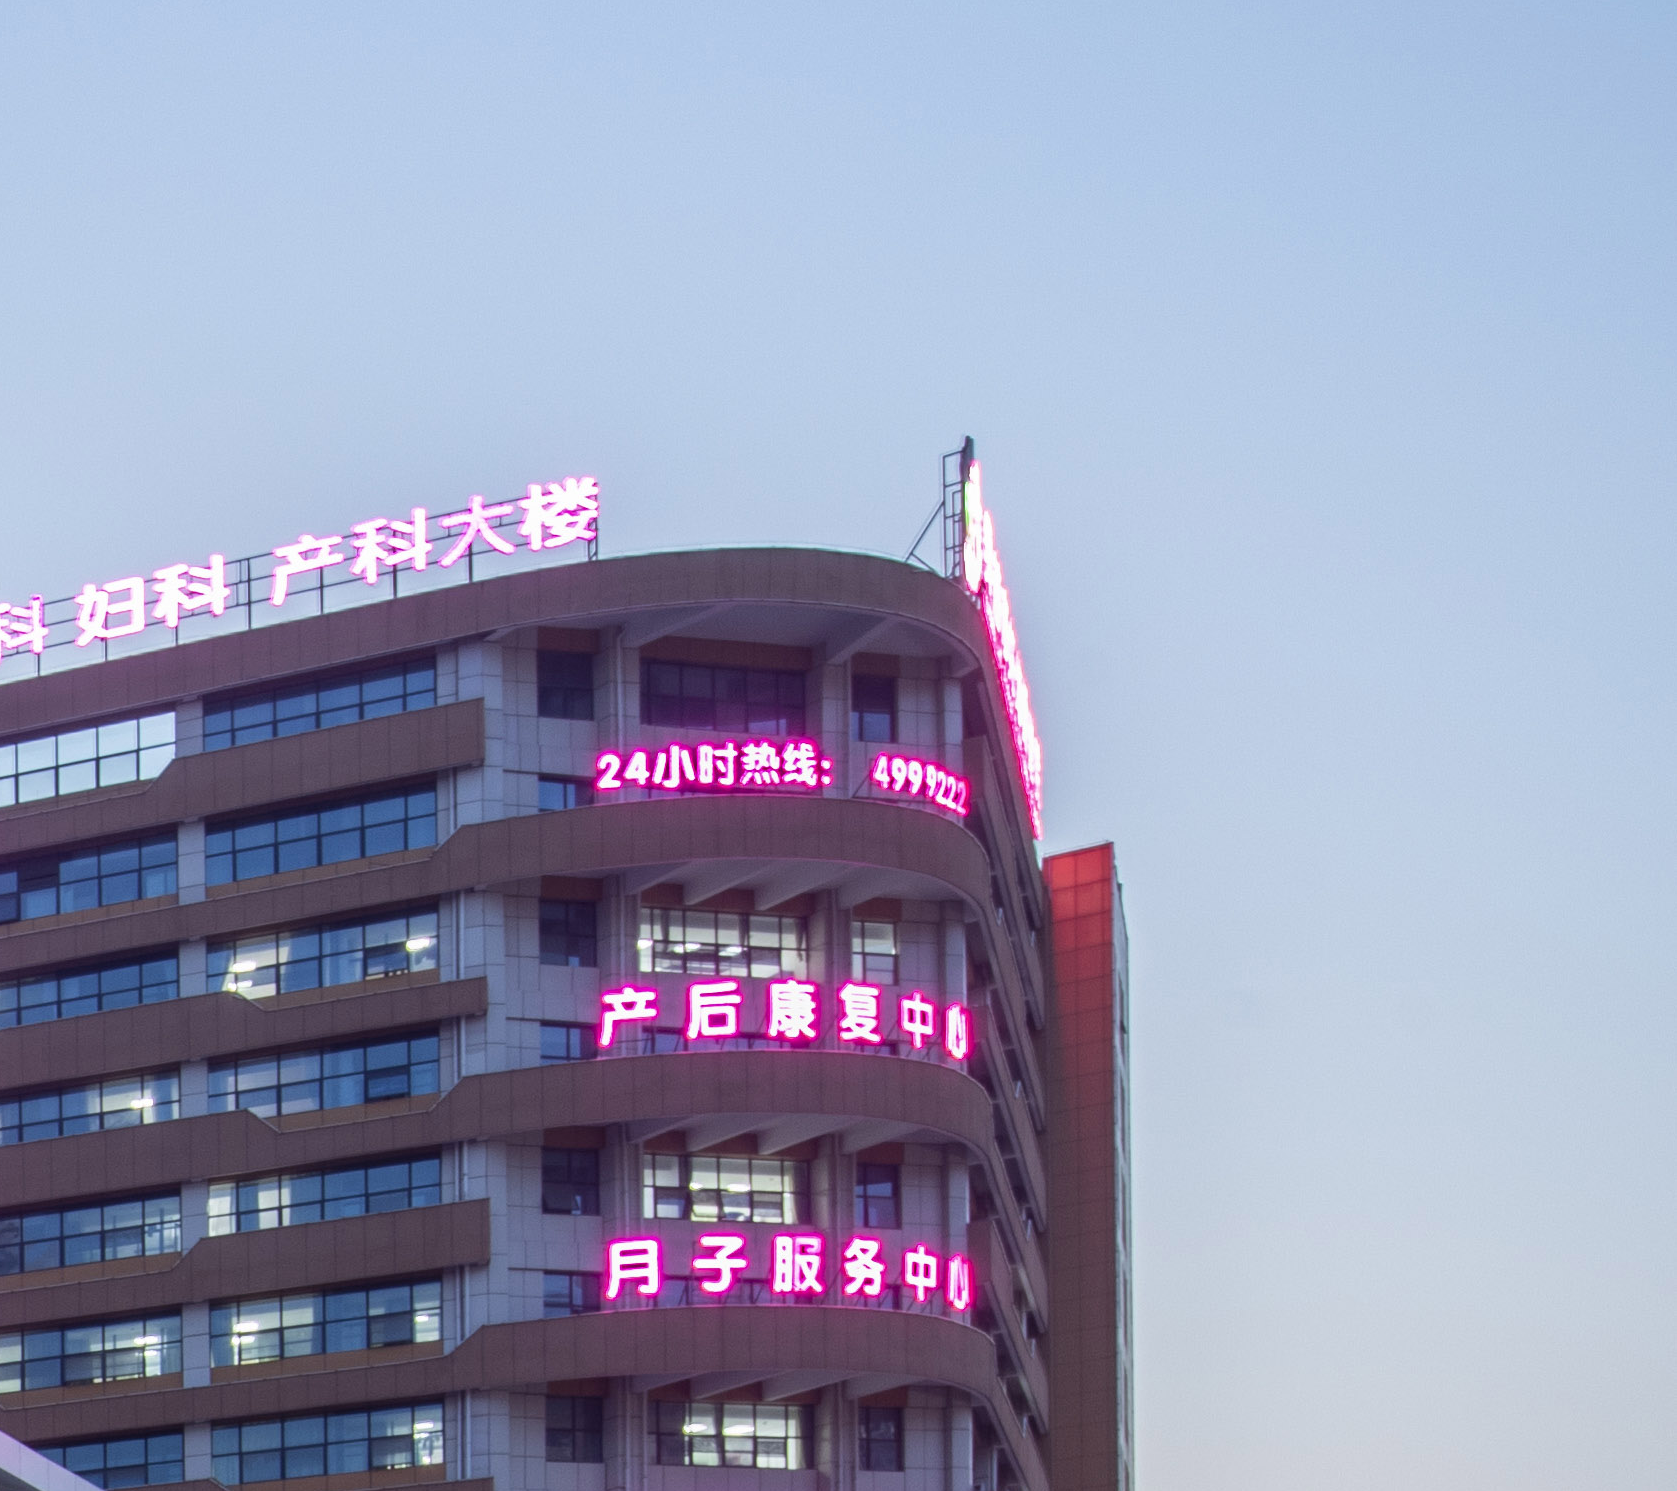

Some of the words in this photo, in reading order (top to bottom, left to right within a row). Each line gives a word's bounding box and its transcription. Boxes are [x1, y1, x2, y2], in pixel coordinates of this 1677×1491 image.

[73, 553, 231, 647] 妇科
[268, 476, 601, 607] 产科大楼
[599, 979, 968, 1060] 产后康复中心
[605, 1234, 970, 1310] 月子服务中心
